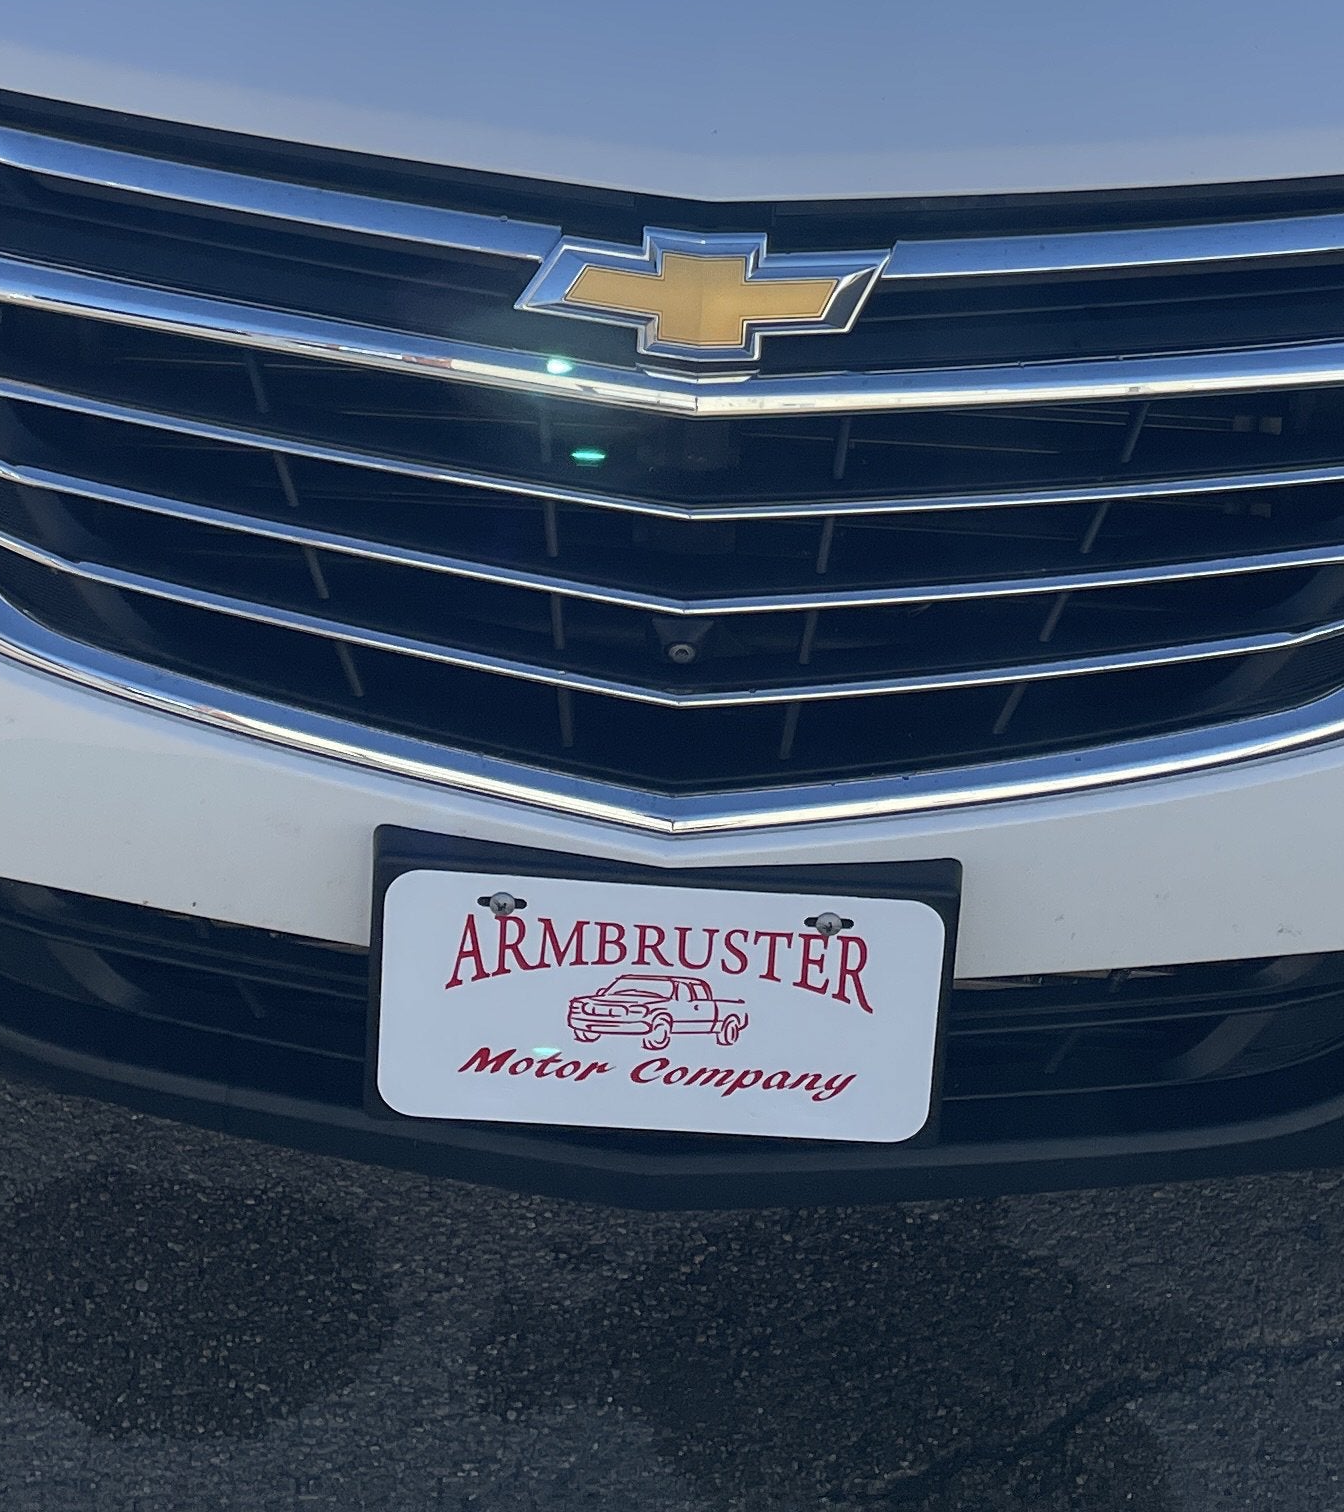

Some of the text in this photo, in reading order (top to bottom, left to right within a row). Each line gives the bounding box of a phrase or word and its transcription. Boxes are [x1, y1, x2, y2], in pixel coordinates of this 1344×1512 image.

[445, 913, 874, 1014] ARMBRUSTER
[457, 1046, 857, 1102] Motor Company
